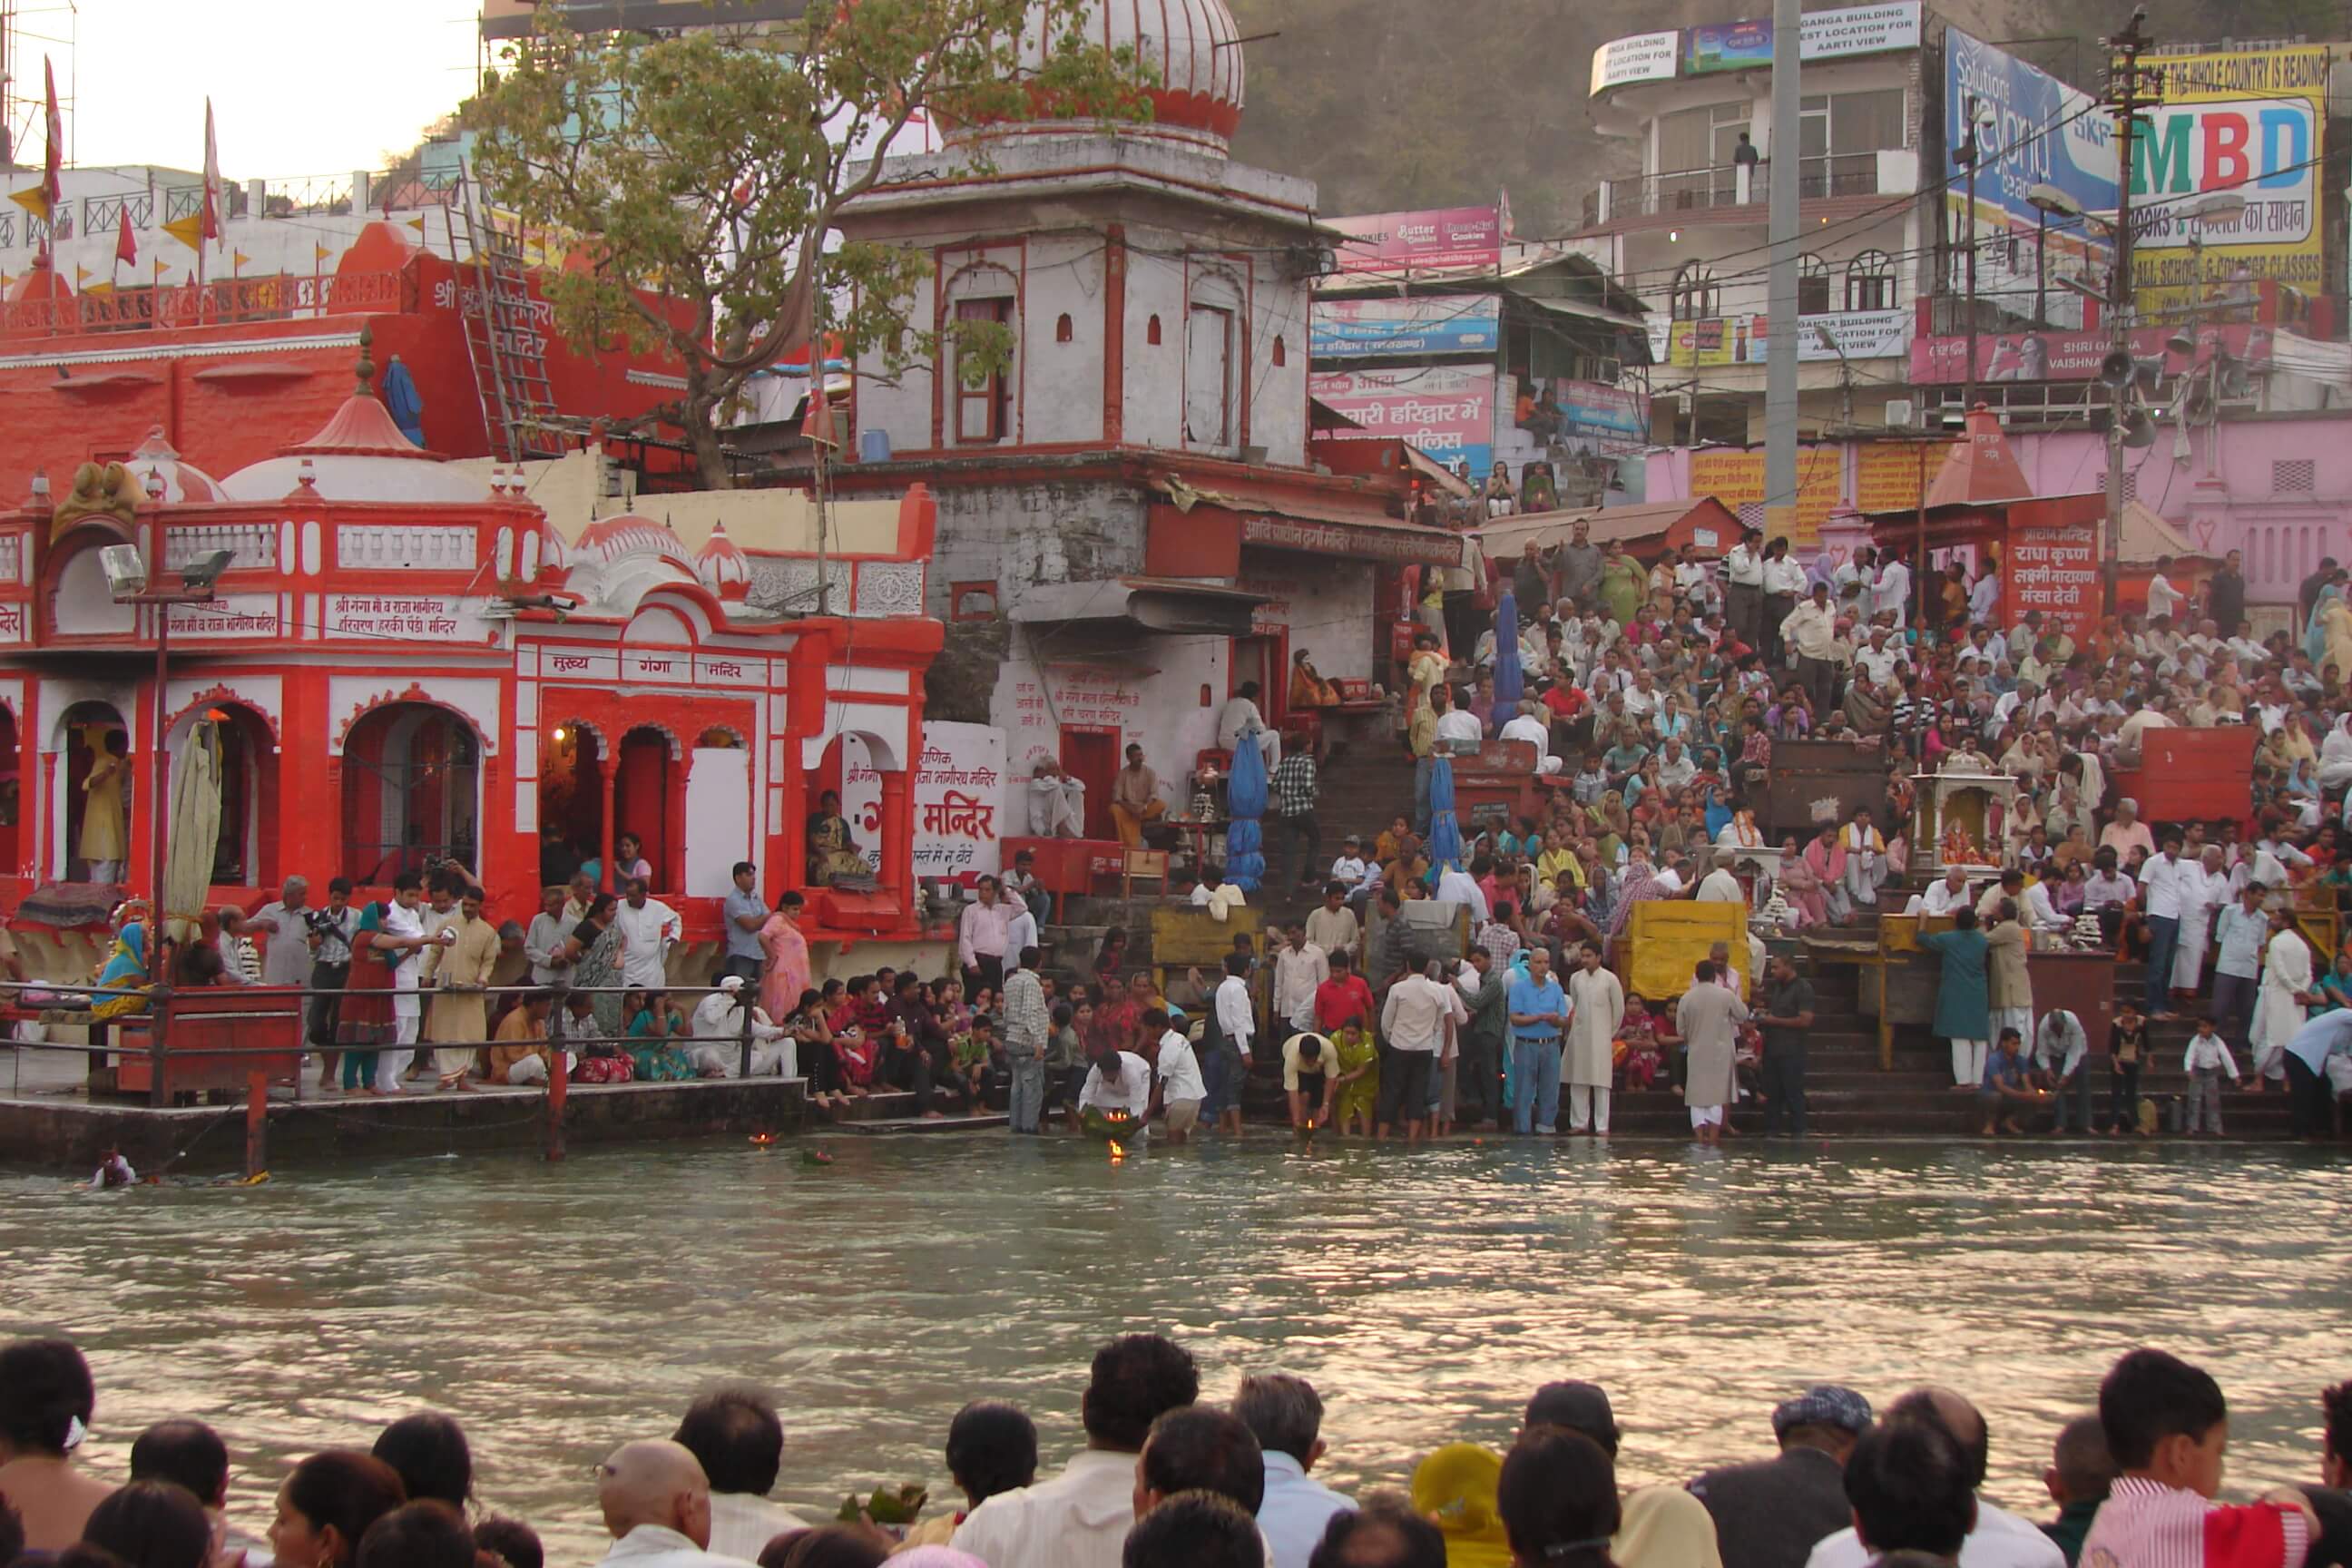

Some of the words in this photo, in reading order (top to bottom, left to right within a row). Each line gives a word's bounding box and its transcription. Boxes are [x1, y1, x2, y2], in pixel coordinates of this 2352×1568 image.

[1846, 8, 1904, 23] BUILDING
[1799, 30, 1822, 41] EST
[1825, 23, 1885, 37] LOCATION
[1888, 20, 1913, 29] FOR
[1626, 37, 1666, 51] BUILDING
[1817, 39, 1853, 52] AARTI
[1856, 35, 1886, 47] VIEW
[1653, 50, 1672, 60] FOR
[1629, 64, 1651, 76] VIEW
[1955, 51, 2011, 106] Solutions
[2170, 62, 2188, 95] THE
[2190, 59, 2223, 94] WHOLE
[2224, 56, 2269, 92] COUNTRY
[2271, 54, 2280, 89] IS
[2283, 53, 2327, 87] READING
[2073, 109, 2112, 148] SKF
[2129, 108, 2308, 195] MBD
[2244, 201, 2264, 233] का
[2267, 199, 2307, 233] साधन
[1397, 224, 1436, 240] Butter
[1407, 234, 1438, 245] Cookies
[1451, 231, 1486, 241] Cookies
[2135, 260, 2157, 287] ALL
[2160, 258, 2198, 285] SCHOO
[2269, 253, 2322, 282] CLASSES
[434, 279, 455, 309] श्री
[1839, 316, 1893, 328] BUILDING
[1798, 332, 1817, 341] EST
[1835, 328, 1876, 338] CATION
[1878, 327, 1902, 336] FOR
[1848, 340, 1877, 349] VIEW
[2063, 341, 2092, 353] SHRI
[1389, 399, 1458, 425] हरिद्वार
[1460, 396, 1484, 421] में
[2014, 545, 2048, 562] राधा
[2051, 546, 2090, 567] कृष्ण
[2051, 569, 2095, 585] नारायण
[2019, 584, 2052, 603] मंसा
[2053, 584, 2080, 605] देवी
[335, 596, 349, 613] श्री
[350, 596, 370, 613] गंगा
[384, 600, 391, 612] व
[393, 600, 411, 613] राजा
[208, 618, 225, 632] राजा
[428, 615, 458, 635] मन्दिर
[552, 656, 591, 672] मुख्य
[639, 656, 672, 673] गंगा
[709, 661, 742, 679] मन्दिर
[918, 747, 952, 765] राणिक
[847, 761, 858, 785] श्री
[968, 766, 997, 789] मन्दिर
[923, 789, 995, 841] मन्दिर
[933, 843, 945, 863] में
[945, 849, 956, 863] न
